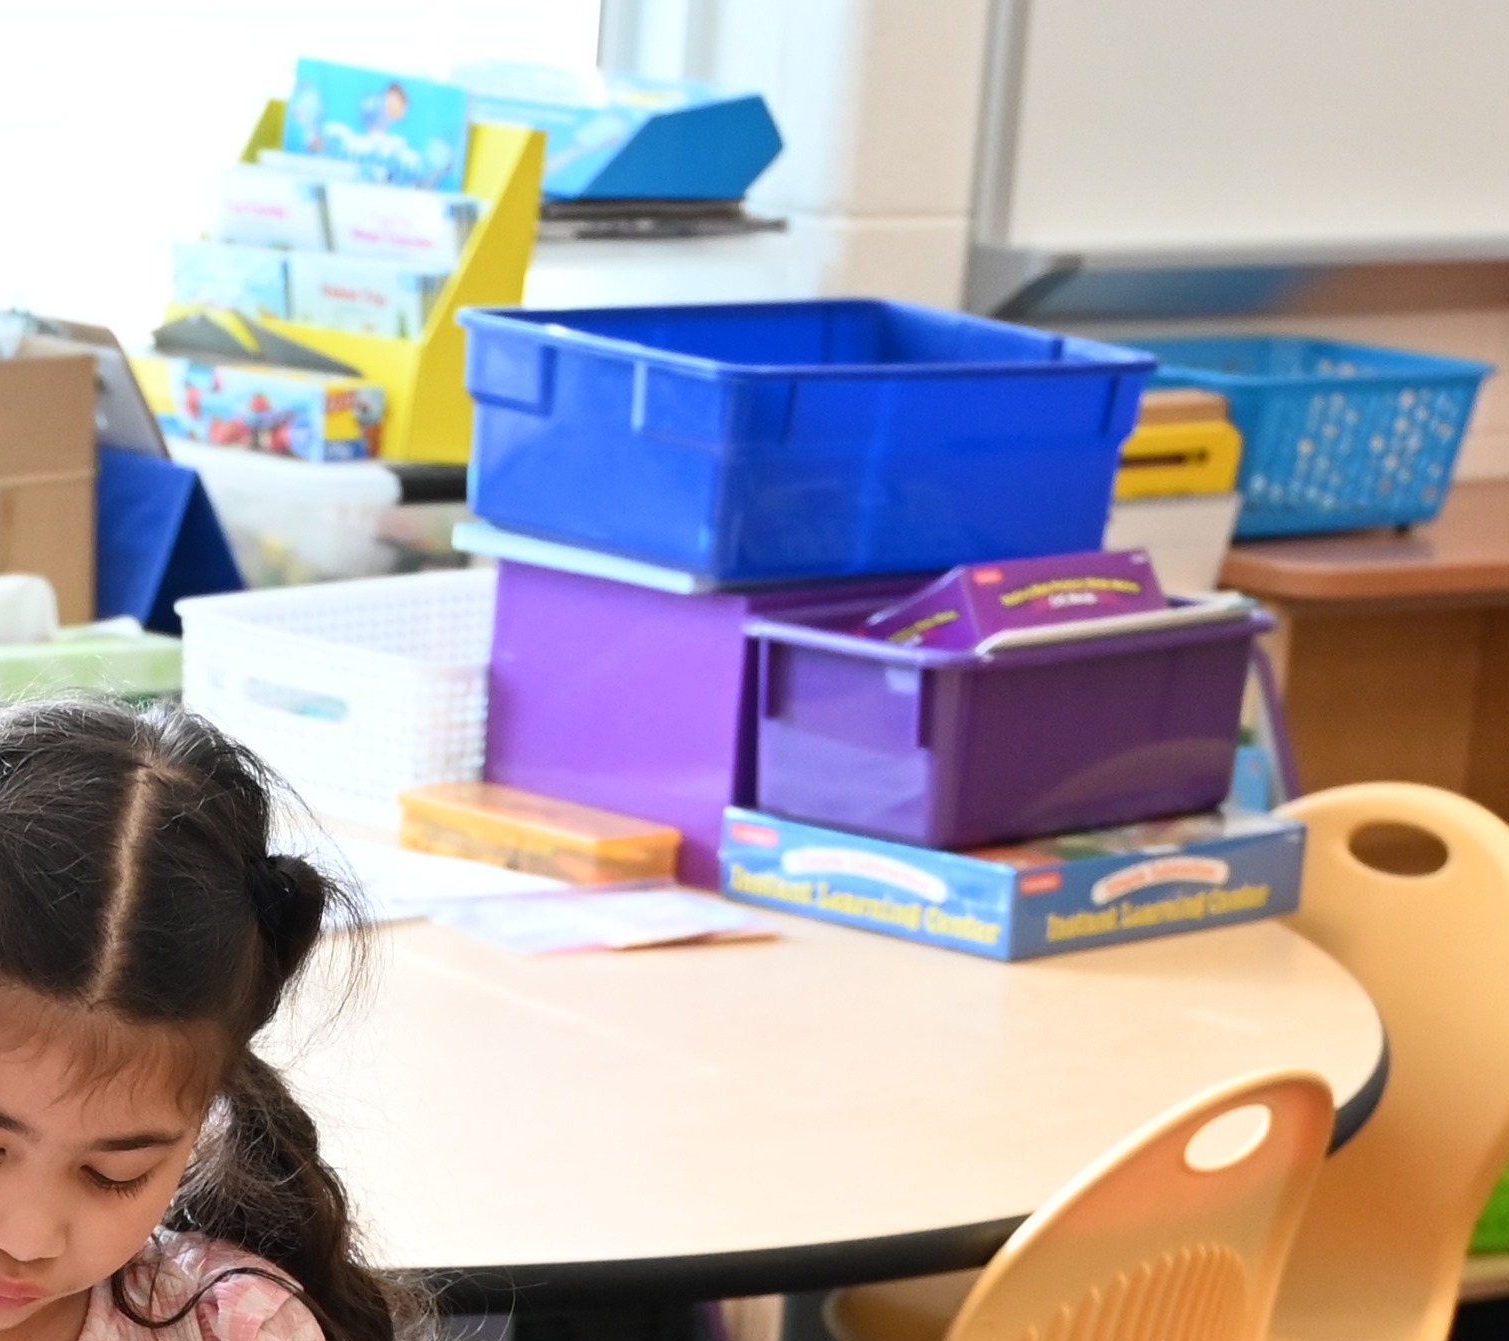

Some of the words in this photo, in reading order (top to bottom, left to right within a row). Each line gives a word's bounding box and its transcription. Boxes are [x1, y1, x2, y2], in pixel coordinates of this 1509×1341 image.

[730, 864, 814, 904] Instant
[818, 880, 923, 931] Learning
[926, 905, 1000, 945] Center
[1046, 908, 1119, 943] Instant
[1121, 892, 1207, 930] Learning
[1210, 883, 1271, 915] Center
